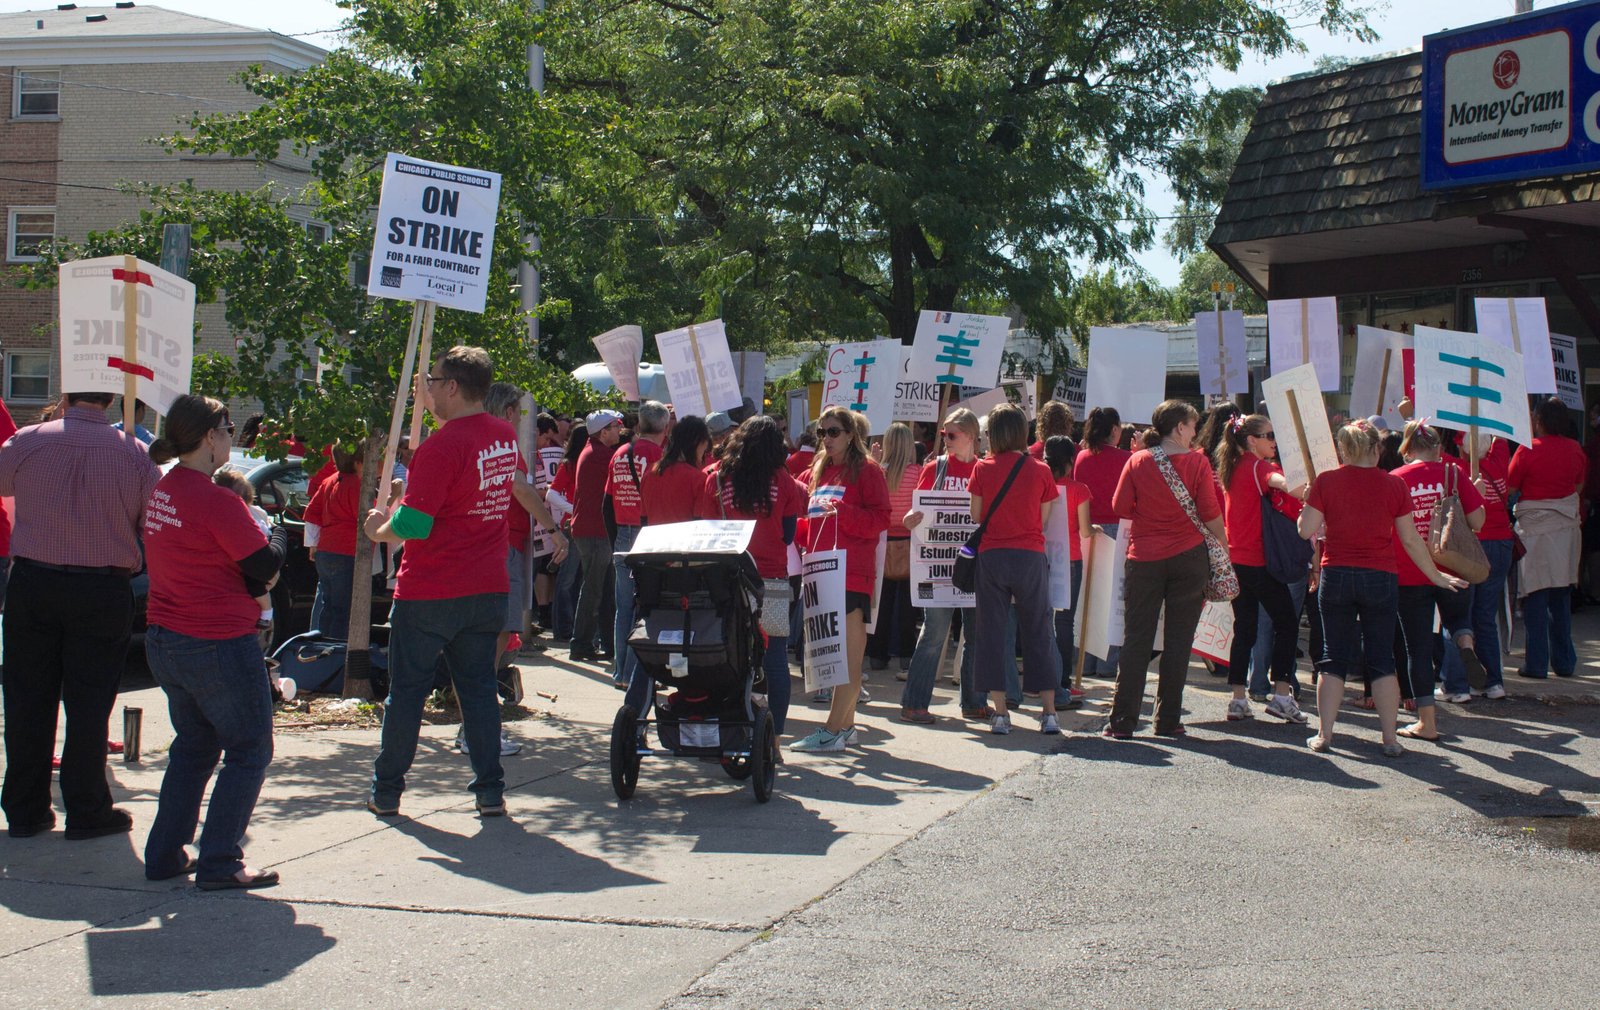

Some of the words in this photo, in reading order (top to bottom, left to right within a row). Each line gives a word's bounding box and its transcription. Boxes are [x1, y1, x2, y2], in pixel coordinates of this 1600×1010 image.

[1449, 89, 1564, 127] MoneyGram
[1450, 129, 1499, 147] International
[1501, 127, 1528, 138] Money
[1530, 119, 1563, 133] Transfer
[398, 163, 430, 175] CHICAGO
[431, 169, 456, 180] PUBLIC
[457, 174, 489, 187] SCHOOLS
[422, 186, 460, 218] ON
[388, 217, 484, 259] STRIKE
[386, 251, 403, 262] FOR
[405, 254, 411, 264] A
[413, 255, 432, 267] FAIR
[434, 258, 480, 276] CONTRACT
[427, 278, 456, 293] Local
[458, 285, 464, 295] 1
[1069, 376, 1082, 389] ON
[1555, 367, 1578, 385] RIKE
[894, 381, 940, 402] STRIKE
[155, 501, 176, 515] Schools
[156, 511, 182, 528] Students
[928, 529, 972, 542] Maestr
[812, 561, 837, 572] SCHOOLS
[804, 580, 819, 609] ON
[818, 644, 840, 657] CONTRACT
